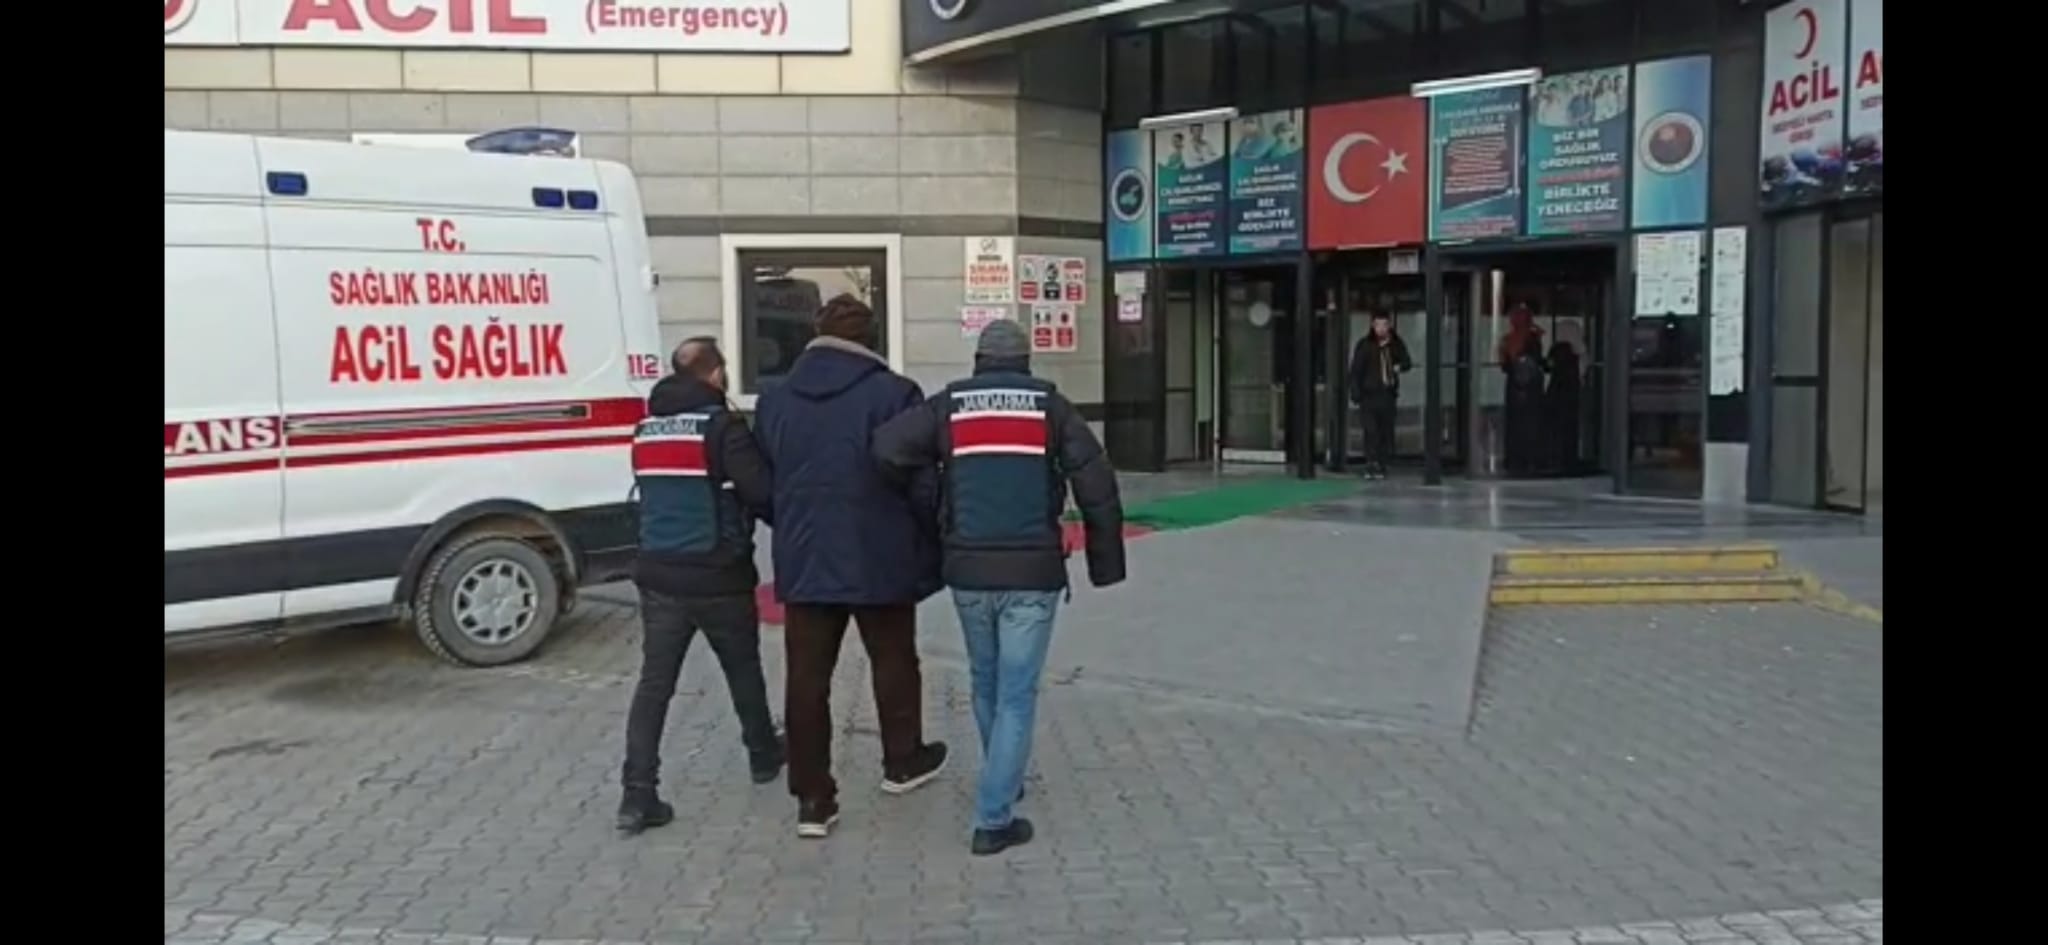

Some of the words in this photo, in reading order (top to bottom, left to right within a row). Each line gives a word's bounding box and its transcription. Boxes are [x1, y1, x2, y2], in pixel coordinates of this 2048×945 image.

[585, 0, 789, 36] (Emergency)
[1768, 60, 1840, 117] ACİL
[416, 217, 466, 252] T.C.
[329, 267, 419, 306] SAĞLIK
[426, 267, 550, 305] BAKANLIĞI
[431, 316, 567, 380] SAĞLIK
[627, 353, 660, 375] 112
[165, 418, 277, 455] ANS
